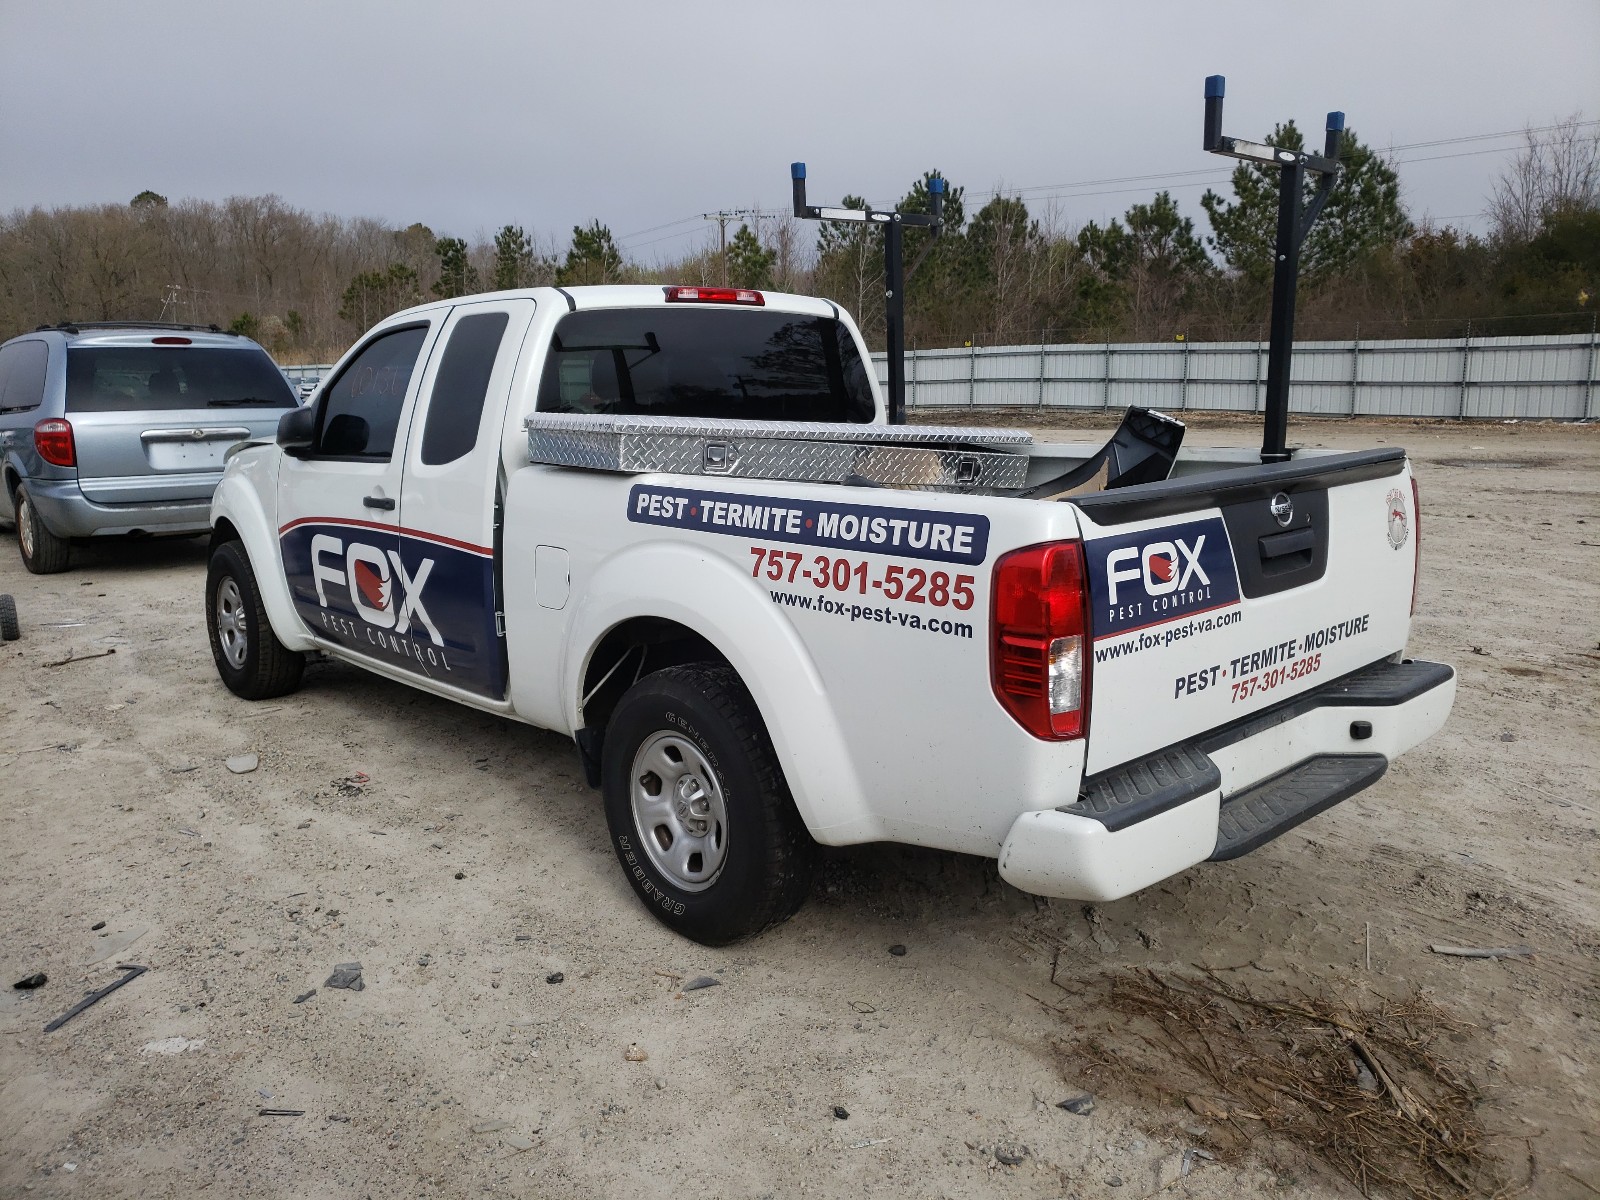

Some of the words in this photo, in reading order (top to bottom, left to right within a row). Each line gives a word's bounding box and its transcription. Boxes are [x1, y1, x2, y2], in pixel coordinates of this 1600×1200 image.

[636, 493, 689, 520] PEST
[700, 502, 803, 534] TERMITE
[816, 512, 975, 554] MOISTURE
[311, 533, 444, 647] FOX
[750, 546, 975, 611] 757-301-5285
[1107, 534, 1211, 605] FOX
[770, 589, 973, 638] www.fox-pest-va.com
[1109, 603, 1143, 623] PEST
[1153, 586, 1211, 612] CONTROL
[321, 611, 356, 637] PEST
[366, 627, 451, 671] CONTROL
[1095, 610, 1242, 663] www.fox-pest-va.com
[1174, 666, 1221, 699] PEST
[1230, 639, 1297, 680] TERMITE
[1303, 614, 1370, 655] MOISTURE
[1231, 653, 1322, 703] 757-301-5285
[618, 835, 686, 916] GRABBER
